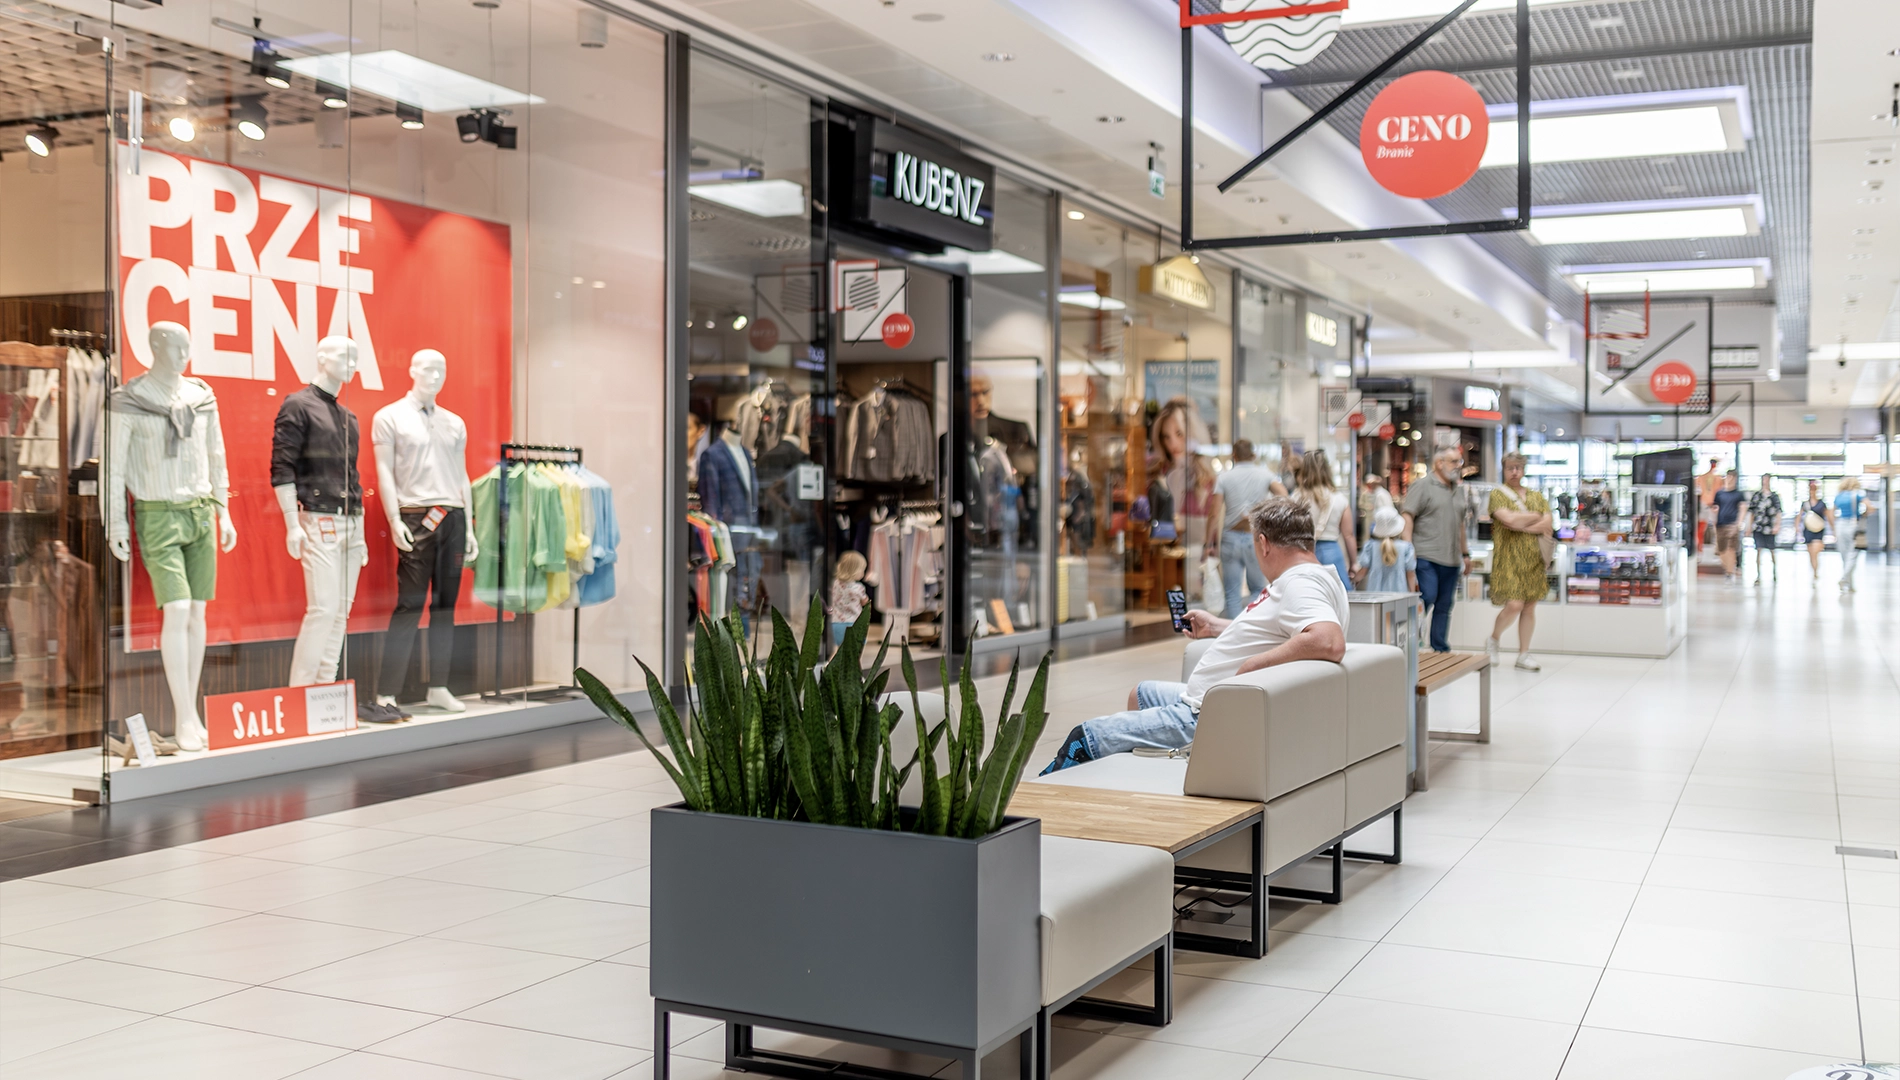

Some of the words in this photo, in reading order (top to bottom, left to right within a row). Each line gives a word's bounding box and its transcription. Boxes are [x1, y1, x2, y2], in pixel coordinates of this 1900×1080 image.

[1377, 113, 1472, 143] CENO
[1376, 145, 1415, 159] Branie
[894, 150, 985, 226] KUBENZ
[117, 143, 374, 295] PRZE
[1164, 268, 1209, 303] WITTCHEN
[122, 257, 385, 391] CENA
[1149, 364, 1217, 376] WITTCHEN
[231, 695, 286, 740] SALE
